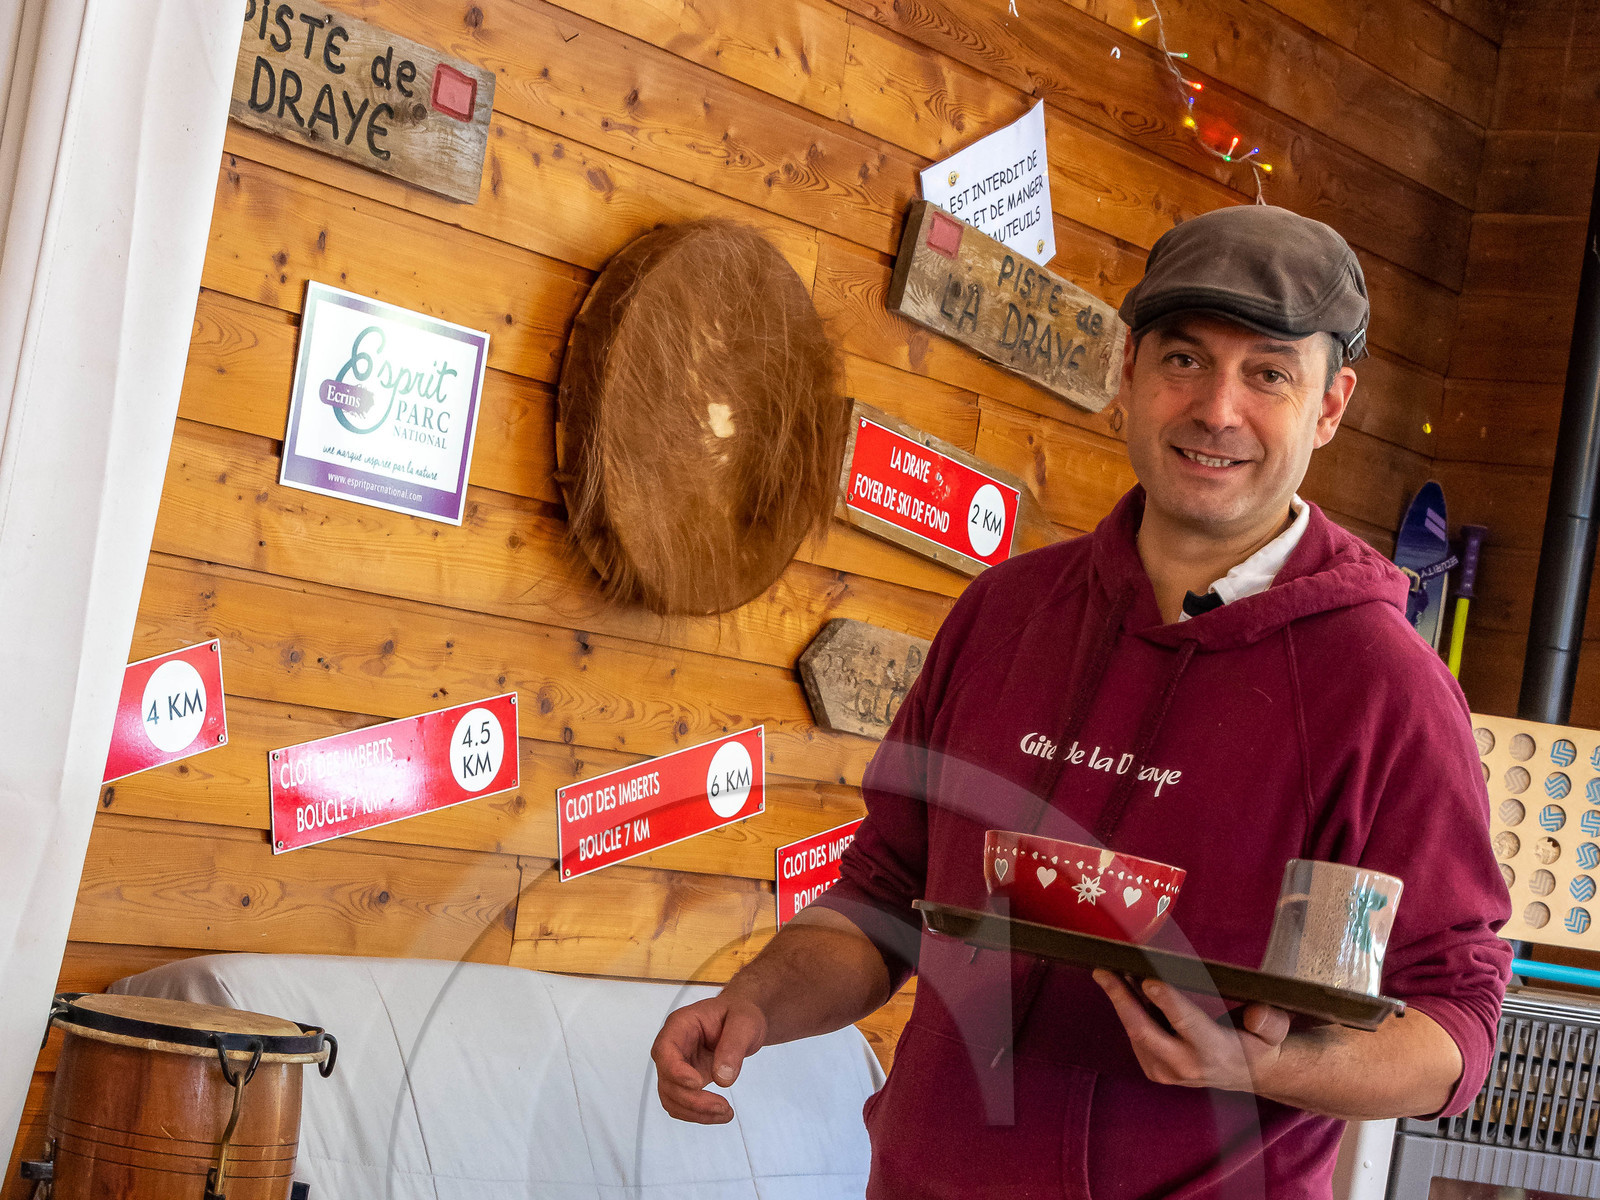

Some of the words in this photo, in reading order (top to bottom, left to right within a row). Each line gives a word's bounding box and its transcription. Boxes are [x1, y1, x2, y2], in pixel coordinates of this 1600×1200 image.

[371, 46, 416, 97] de
[248, 55, 395, 161] DRAYE
[950, 189, 969, 215] EST
[972, 160, 1025, 202] INTERDIT
[1027, 150, 1038, 172] DE
[974, 208, 987, 229] ET
[990, 199, 1004, 220] DE
[1007, 174, 1044, 212] MANGER
[988, 206, 1041, 242] AUTEUILS
[998, 255, 1063, 316] PISTE
[1075, 305, 1103, 337] de
[940, 275, 981, 334] LA
[999, 302, 1086, 370] DRAYE
[335, 326, 457, 434] Esprit
[327, 384, 361, 408] Ecrins
[395, 400, 451, 434] PARC
[393, 425, 448, 450] NATIONAL
[328, 472, 423, 502] www.espritparcnational.com
[337, 448, 362, 462] marque
[393, 462, 405, 473] par
[406, 461, 413, 473] la
[416, 466, 438, 481] nature
[890, 446, 901, 471] LA
[902, 451, 931, 483] DRAYE
[854, 473, 881, 506] FOYER
[883, 485, 895, 511] DE
[896, 491, 912, 517] SKI
[911, 498, 924, 523] DE
[924, 503, 950, 533] FOND
[971, 504, 980, 525] 2
[982, 508, 1002, 536] KM
[146, 699, 159, 725] 4
[168, 688, 203, 720] KM
[462, 720, 491, 746] 4.5
[280, 759, 313, 790] CLOT
[317, 751, 345, 779] DES
[343, 737, 394, 771] IMBERTS
[463, 750, 492, 779] KM
[710, 774, 720, 797] 6
[726, 766, 751, 793] KM
[1020, 732, 1057, 760] Gite
[1087, 746, 1114, 773] la
[1116, 753, 1182, 798] Daye
[296, 799, 348, 832] BOUCLE
[362, 795, 383, 815] KM
[565, 793, 594, 823] CLOT
[596, 785, 616, 813] DES
[618, 771, 660, 806] IMBERTS
[579, 828, 622, 862] BOUCLE
[624, 823, 631, 846] 7
[633, 817, 650, 843] KM
[783, 851, 807, 879] CLOT
[809, 844, 827, 870] DES
